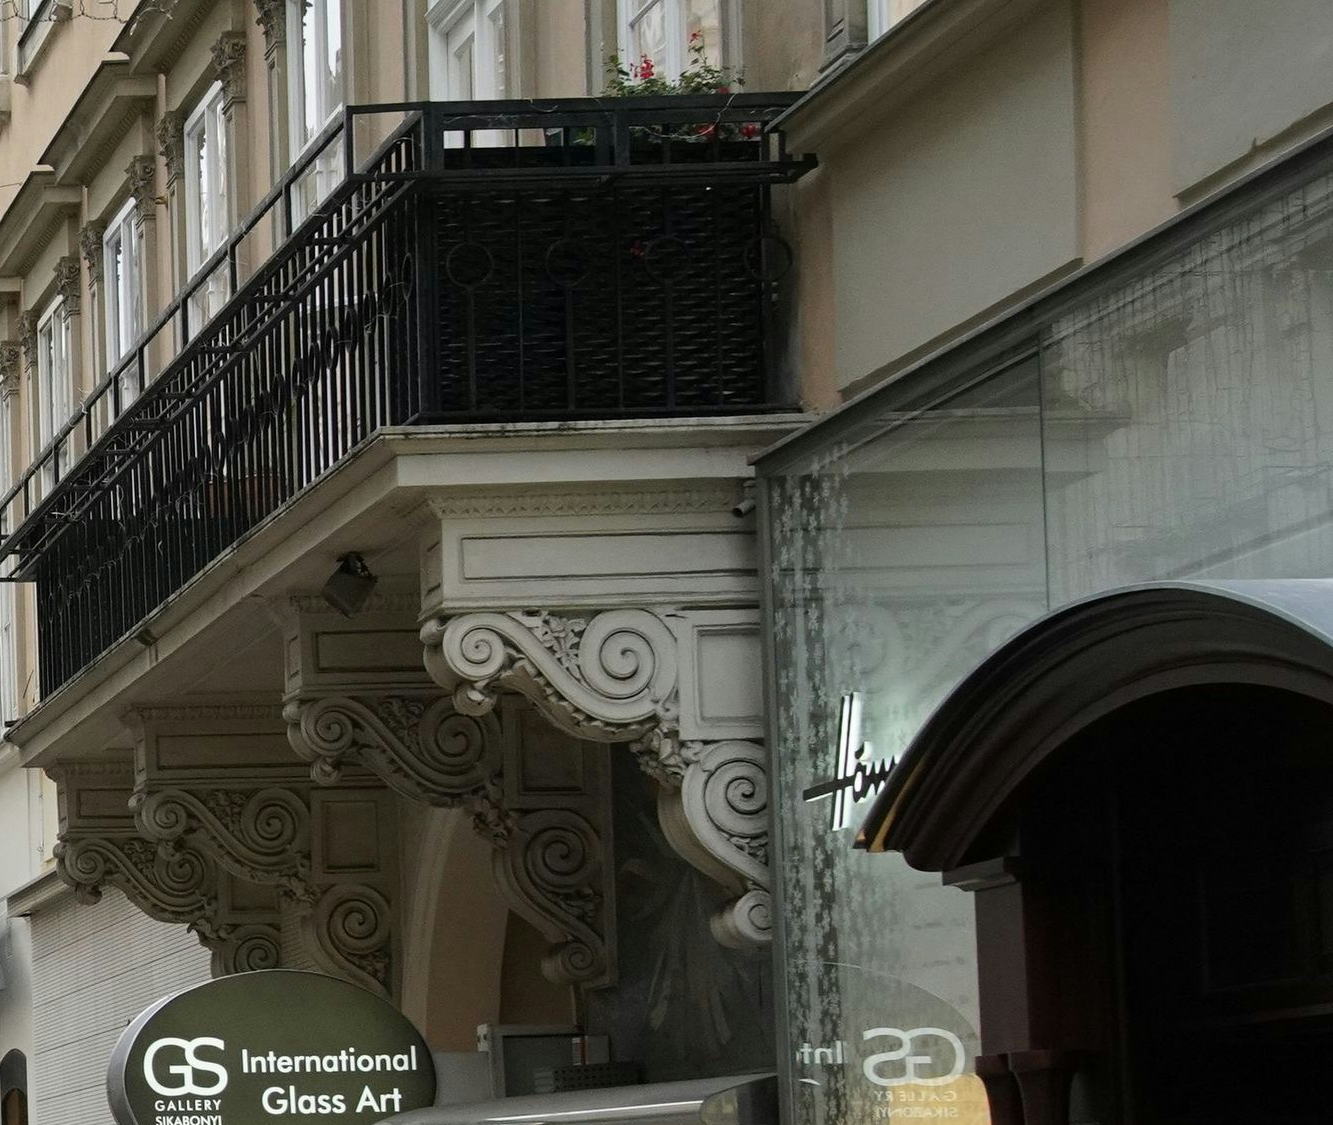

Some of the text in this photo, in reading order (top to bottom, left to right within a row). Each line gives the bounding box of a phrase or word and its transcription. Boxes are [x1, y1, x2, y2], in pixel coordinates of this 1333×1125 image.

[144, 1037, 228, 1096] GS
[242, 1045, 417, 1073] International
[154, 1100, 221, 1112] GALLERY
[262, 1085, 402, 1115] Glass Art
